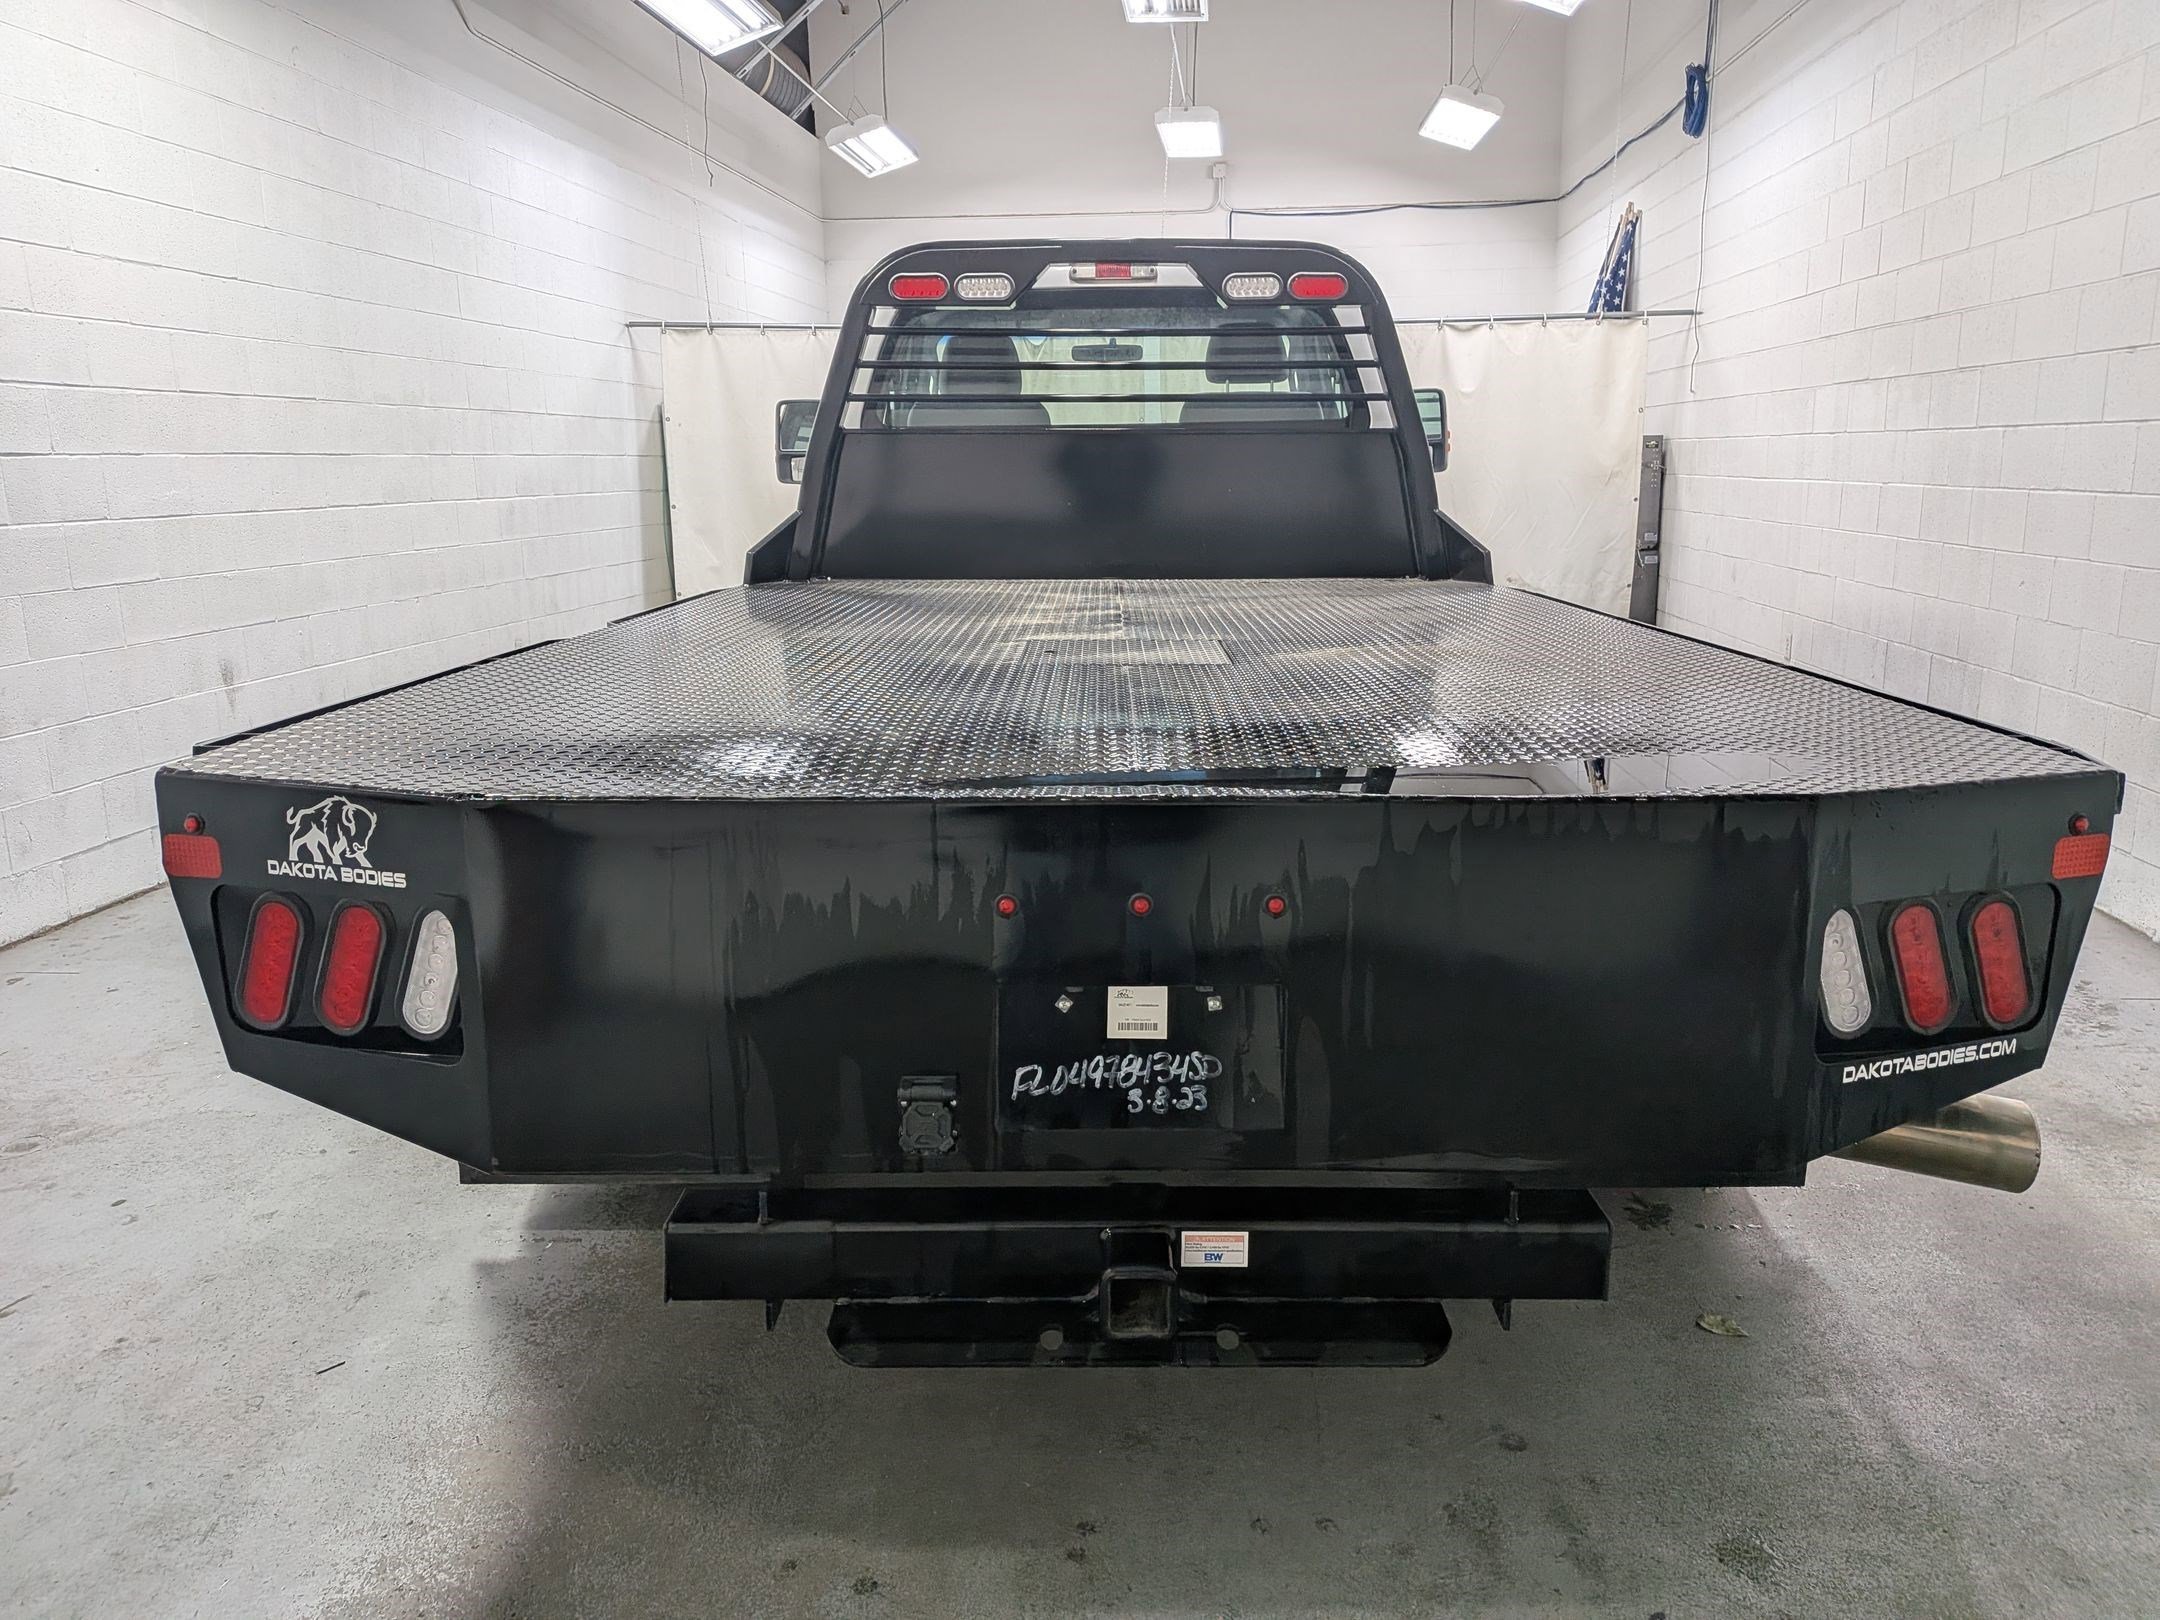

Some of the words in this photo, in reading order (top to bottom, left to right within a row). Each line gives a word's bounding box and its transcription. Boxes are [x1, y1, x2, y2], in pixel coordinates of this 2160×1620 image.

[267, 860, 338, 881] DAKOTA
[340, 868, 407, 888] BODIES
[1842, 1038, 2017, 1083] DAKOTABODIES.COM
